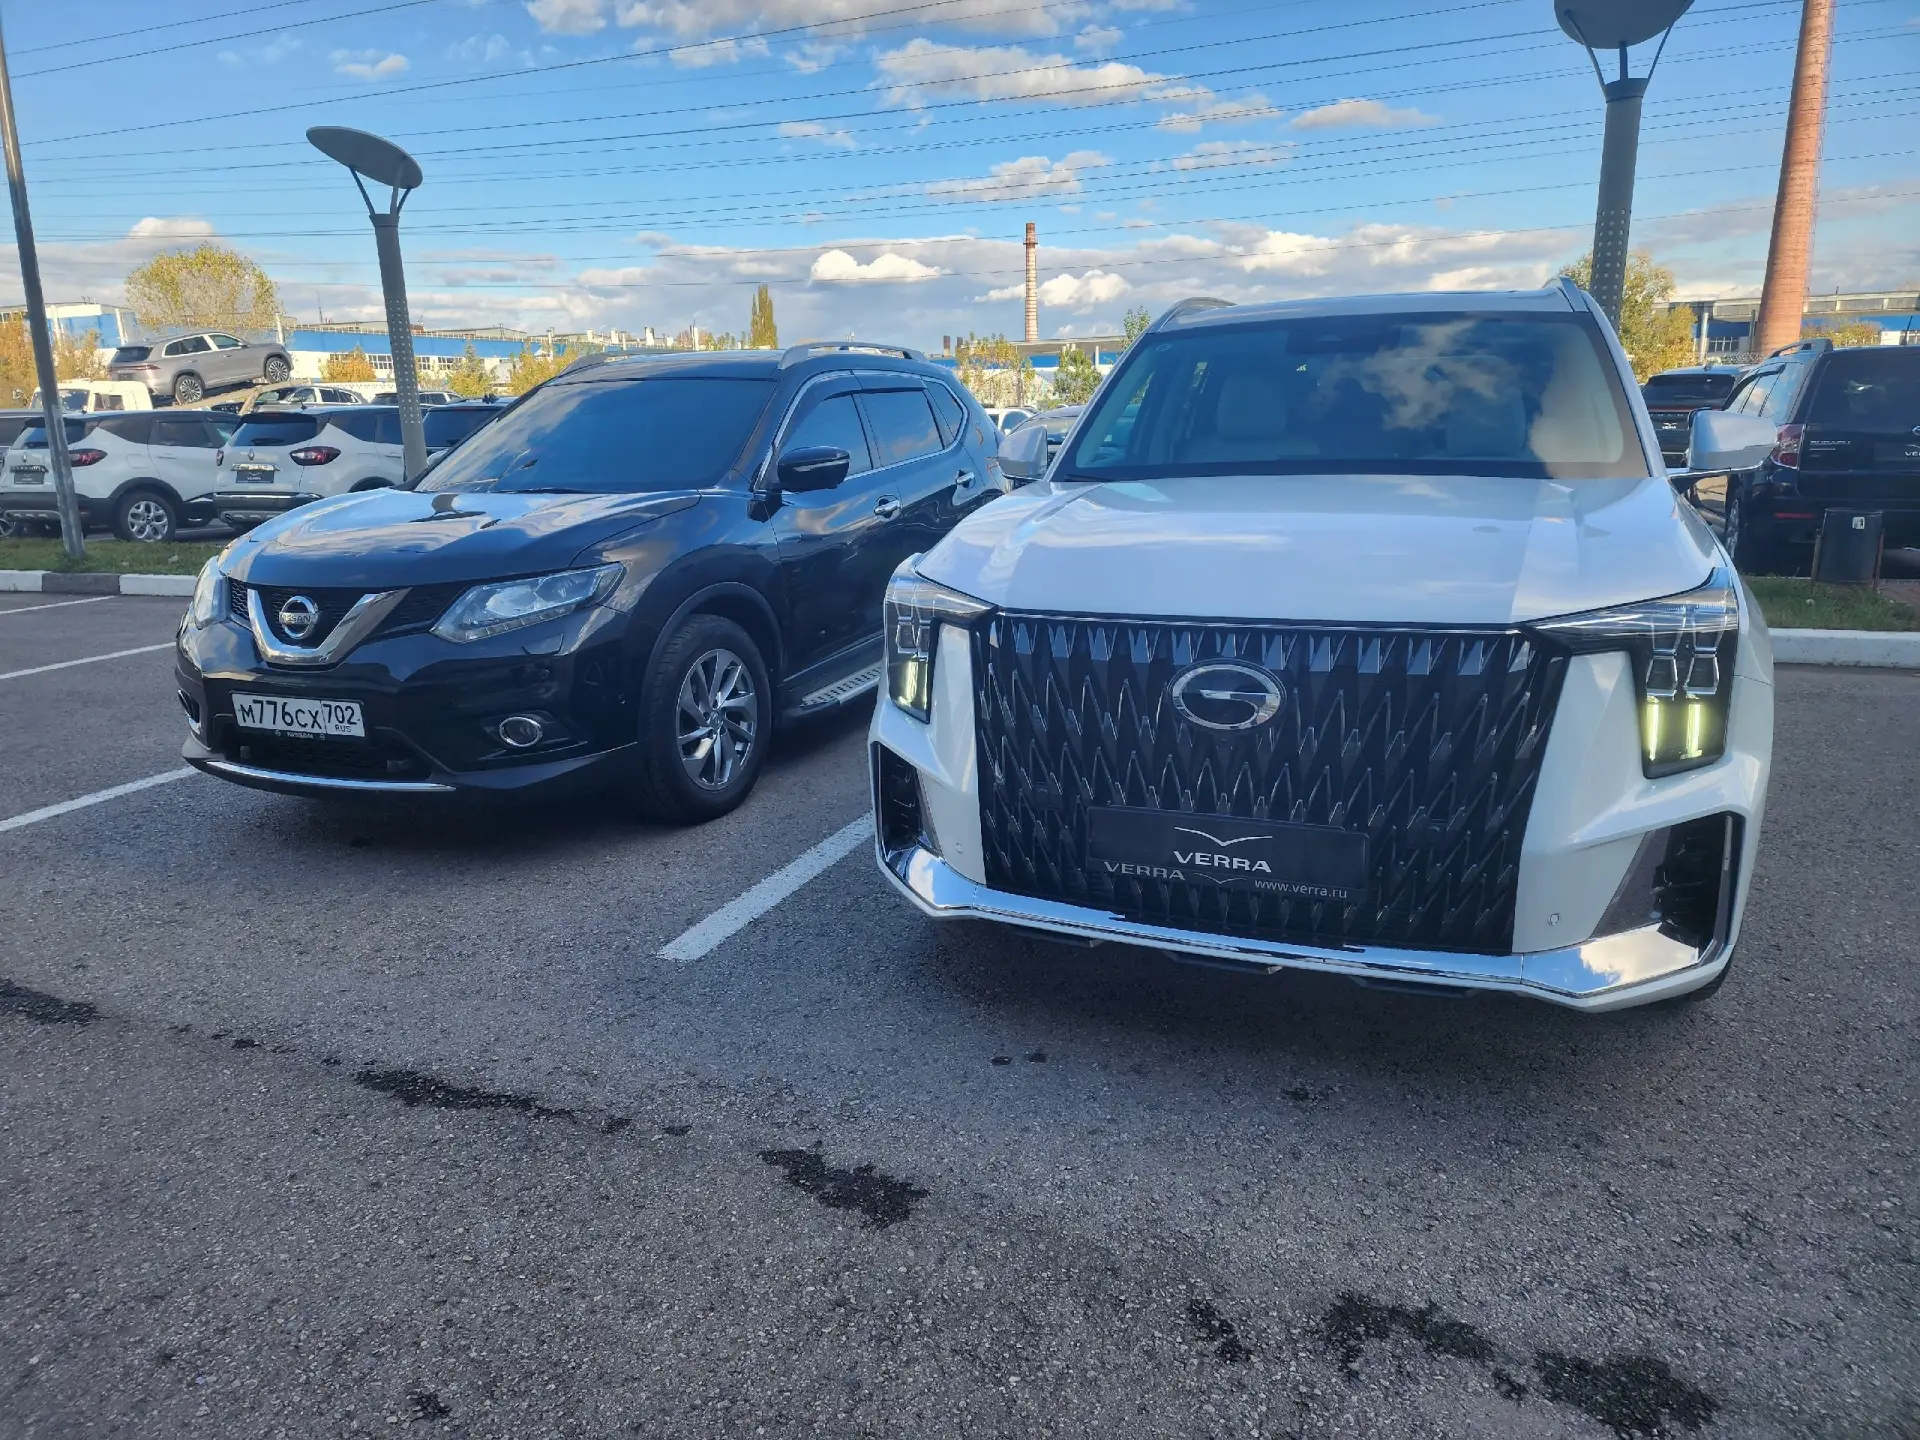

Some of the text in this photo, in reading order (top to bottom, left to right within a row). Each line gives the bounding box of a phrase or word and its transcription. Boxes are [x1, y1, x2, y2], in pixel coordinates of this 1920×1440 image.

[323, 703, 357, 725] 702
[335, 724, 351, 733] RUS
[1104, 861, 1185, 880] VERRA
[1173, 851, 1272, 873] VERRA
[1254, 879, 1347, 900] www.verra.ru
